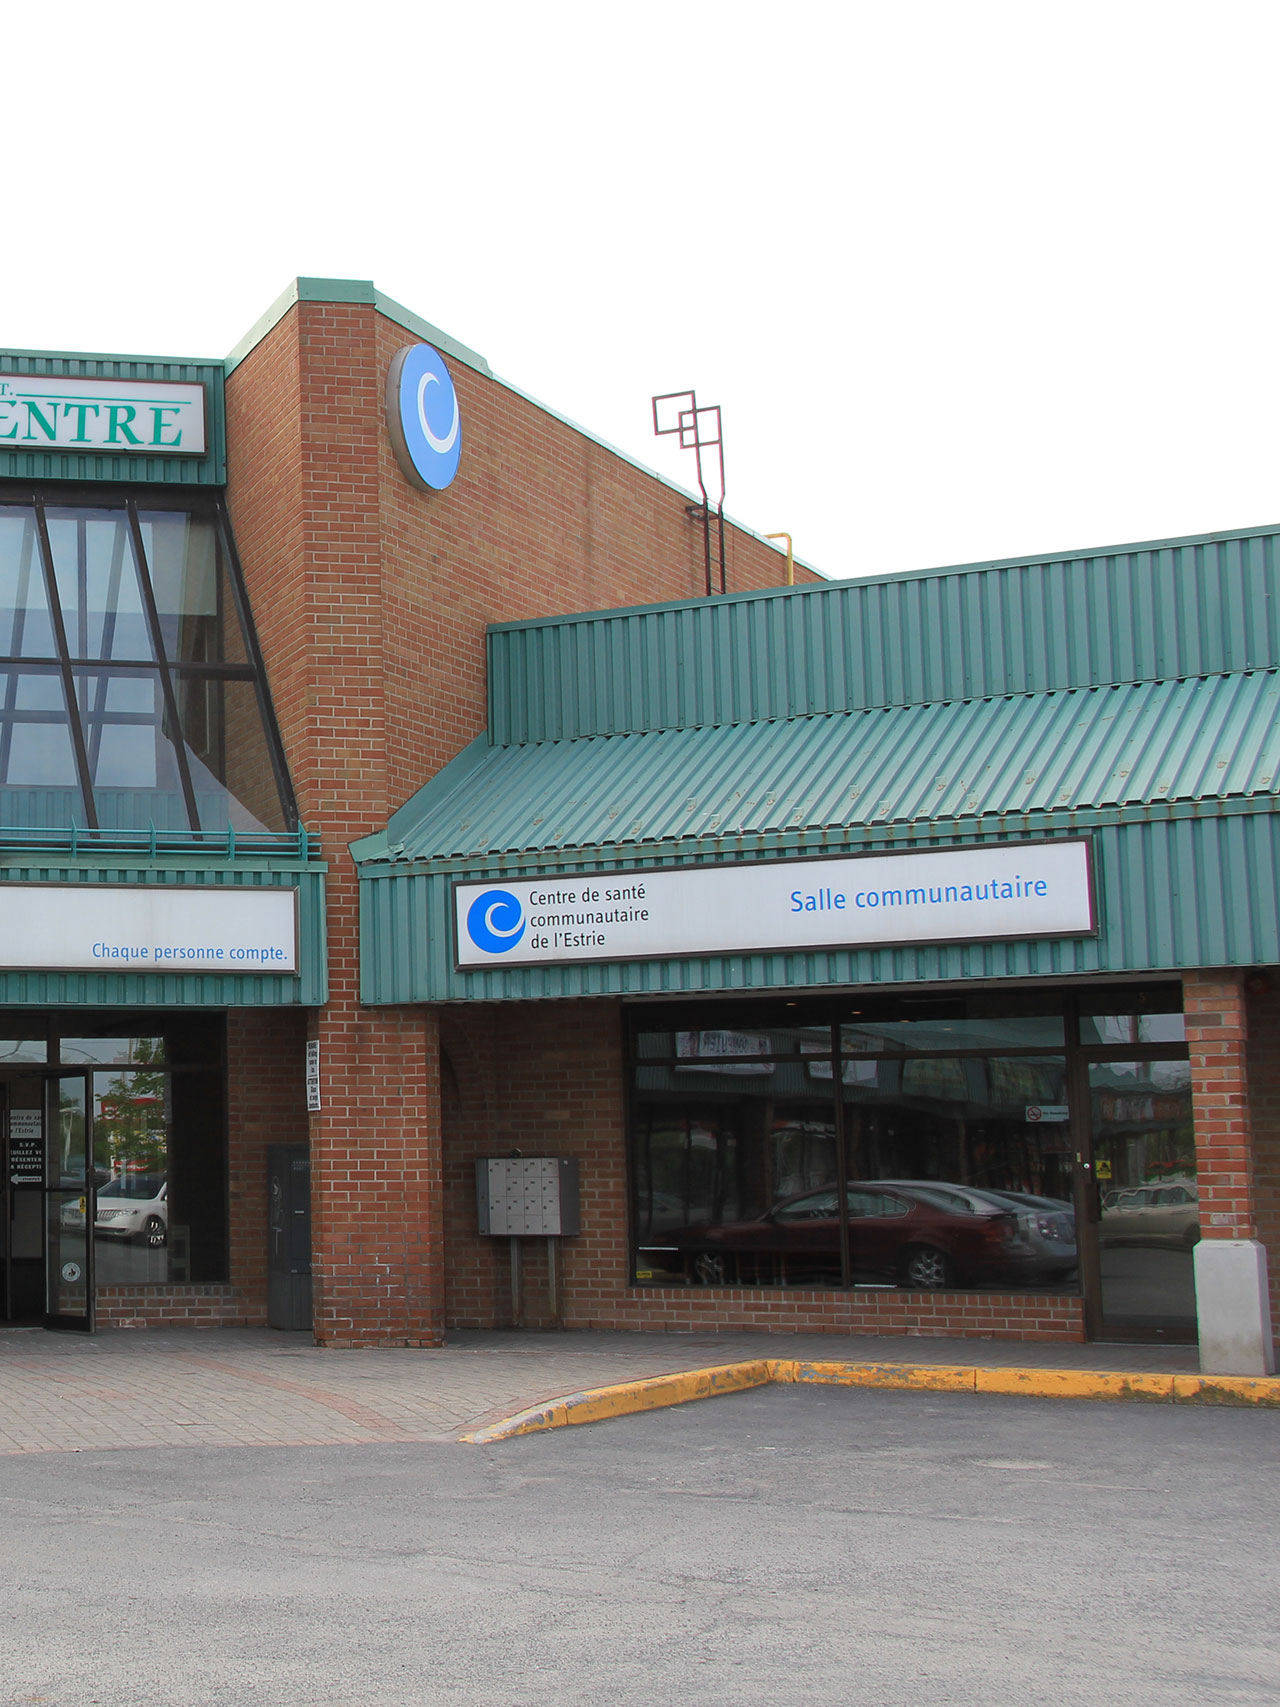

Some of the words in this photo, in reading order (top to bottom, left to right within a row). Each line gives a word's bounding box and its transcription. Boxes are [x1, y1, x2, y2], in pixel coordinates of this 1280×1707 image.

[530, 890, 576, 905] Centre
[582, 887, 600, 902] de
[605, 883, 646, 901] santé
[791, 888, 846, 912] Salle
[855, 875, 1048, 908] communautaire
[530, 906, 649, 927] communautaire
[531, 934, 549, 949] de
[92, 943, 149, 961] Chaque
[154, 947, 224, 962] personne
[229, 946, 288, 963] compte.
